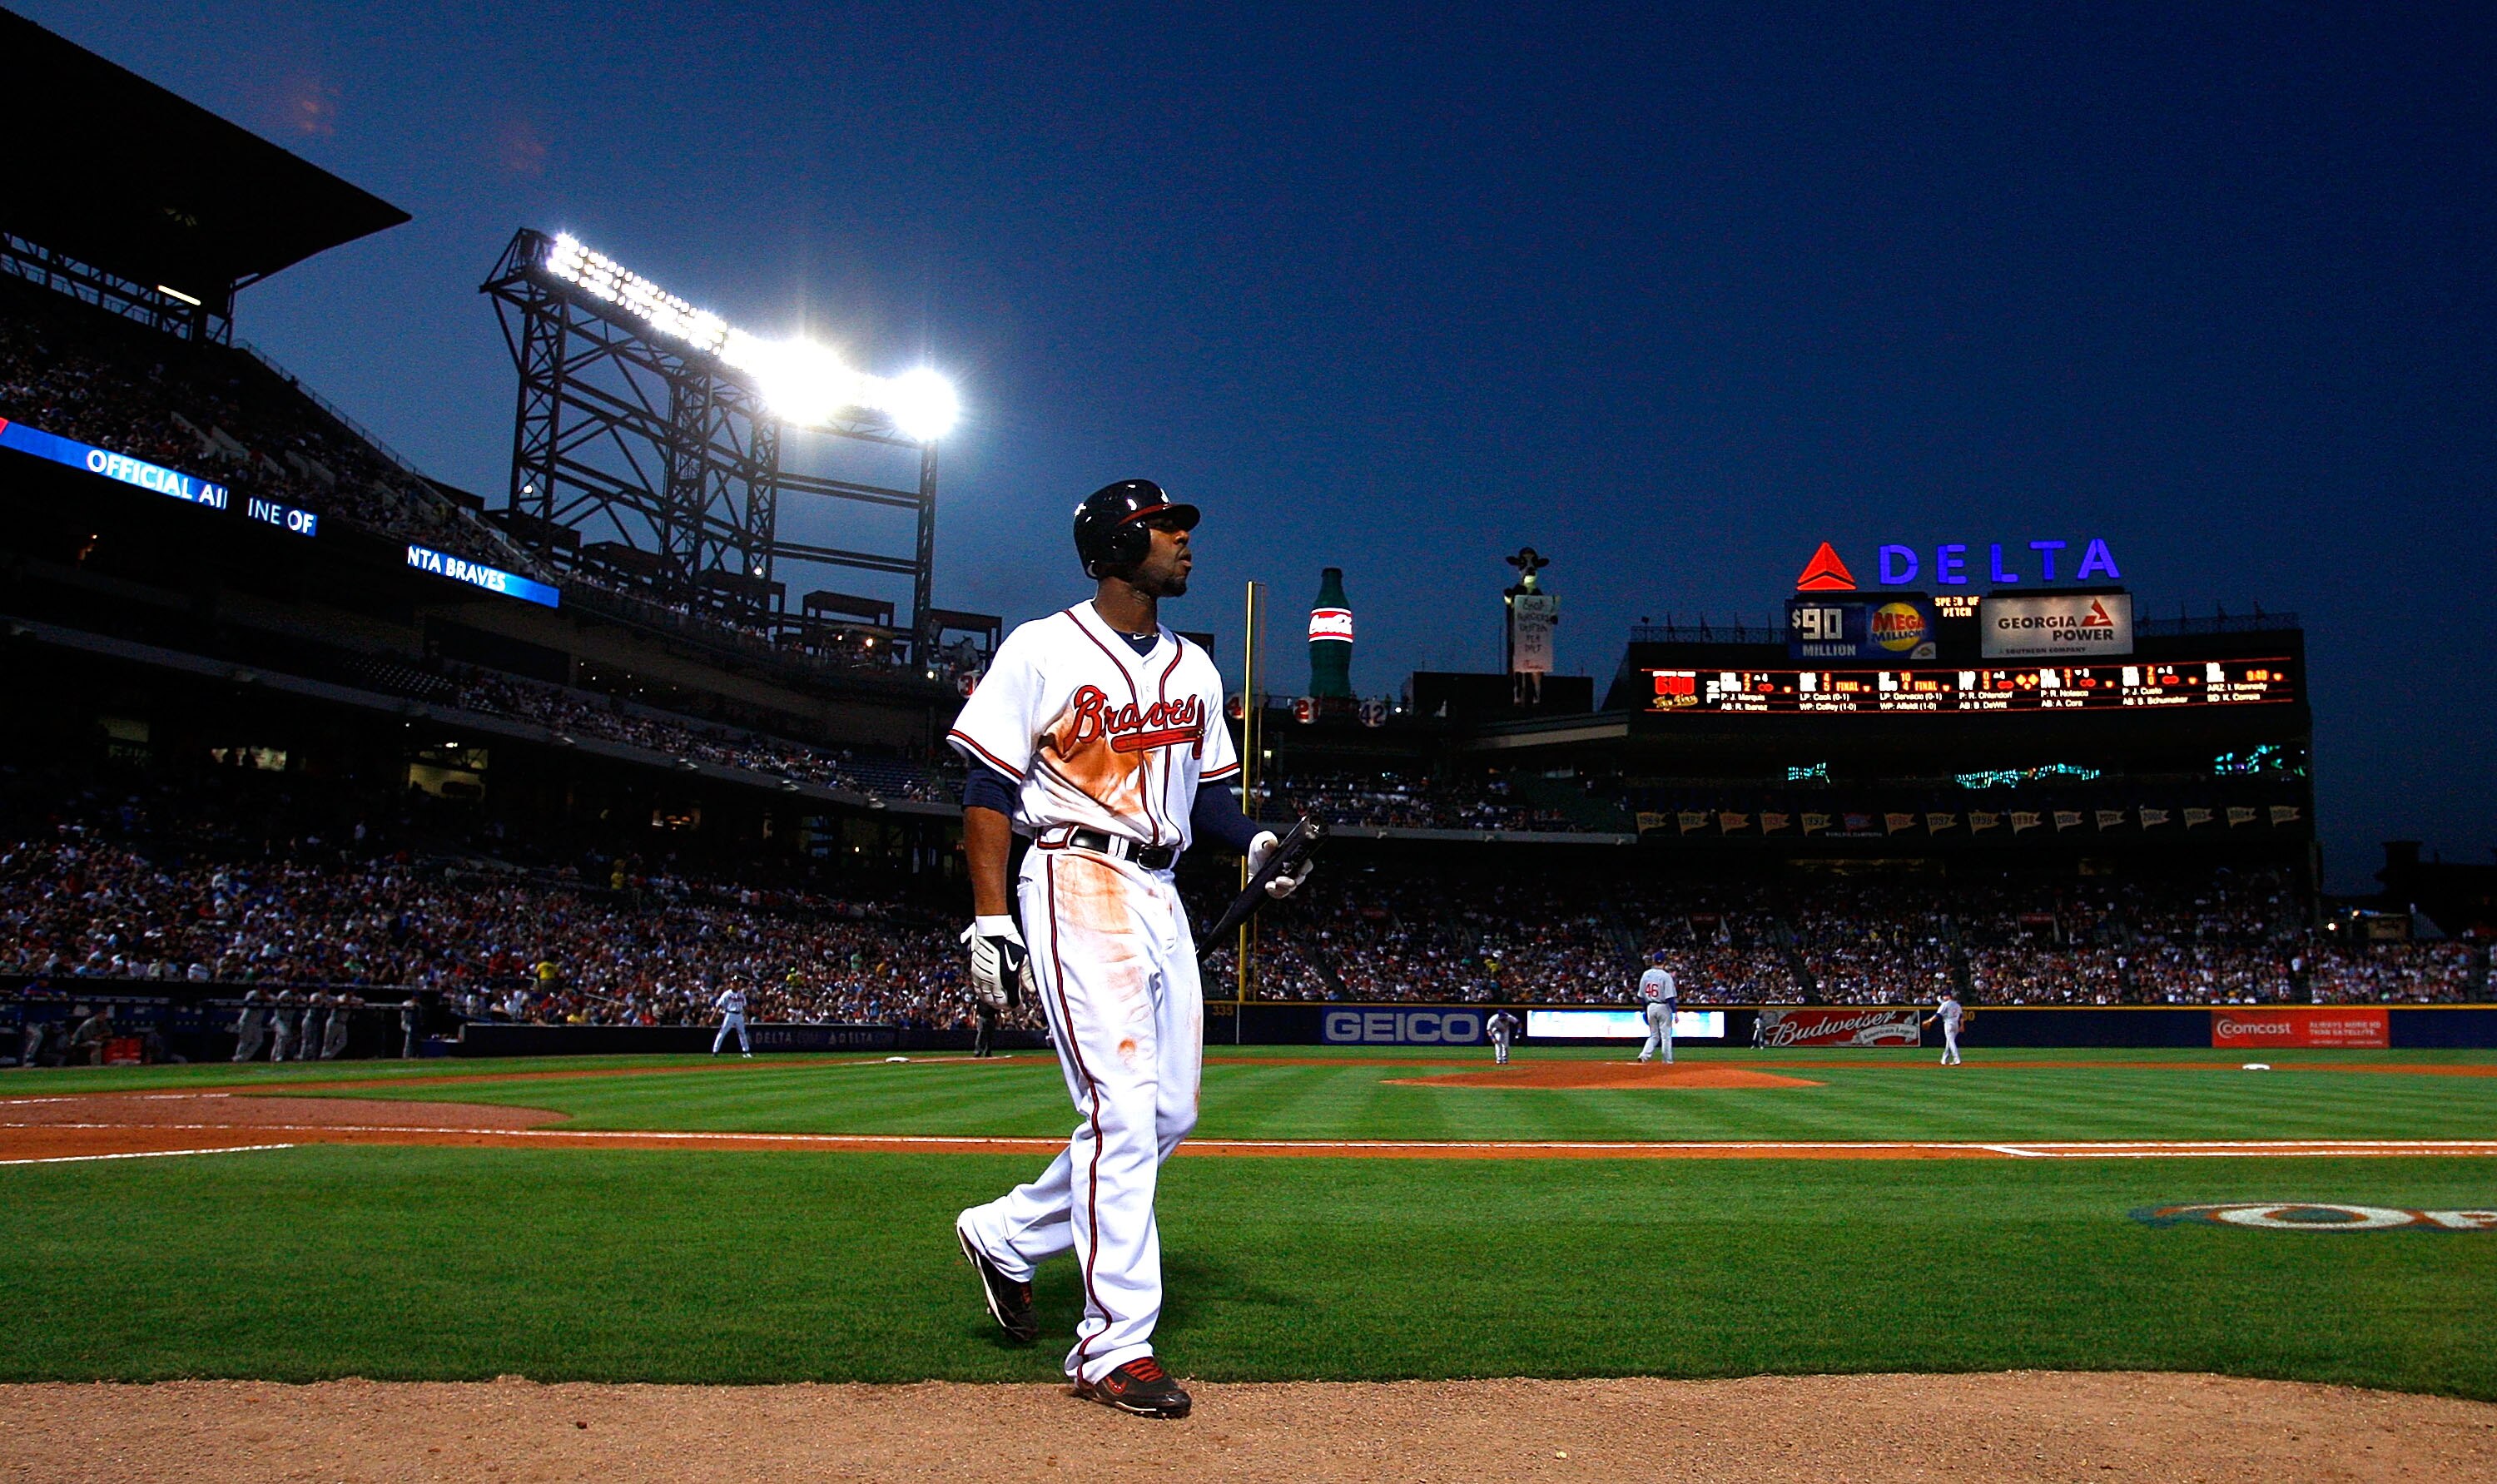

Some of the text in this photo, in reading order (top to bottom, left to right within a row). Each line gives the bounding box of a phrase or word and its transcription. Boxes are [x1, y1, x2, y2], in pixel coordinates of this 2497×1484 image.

[86, 449, 193, 499] OFFICIAL
[287, 509, 315, 534] OF
[1879, 538, 2121, 585] DELTA
[445, 557, 506, 592] BRAVES
[1967, 596, 1980, 606] OF
[1871, 612, 1926, 633] MEGA
[1998, 616, 2078, 629] GEORGIA
[2053, 628, 2114, 641] POWER
[1802, 644, 1857, 658] MILLION
[1900, 672, 1911, 682] 10
[1823, 682, 1830, 692] 5
[1836, 681, 1859, 692] FINAL
[1914, 681, 1938, 691] FINAL
[1294, 699, 1321, 719] 21
[1359, 704, 1385, 724] 42
[1063, 684, 1199, 753] Braves
[1645, 983, 1659, 998] 46
[1212, 1005, 1234, 1016] 335
[1325, 1012, 1480, 1043] GEICO
[1765, 1010, 1897, 1045] Budweiser
[2217, 1019, 2291, 1039] Comcast
[755, 1031, 792, 1045] DELTA
[836, 1031, 873, 1045] DELTA
